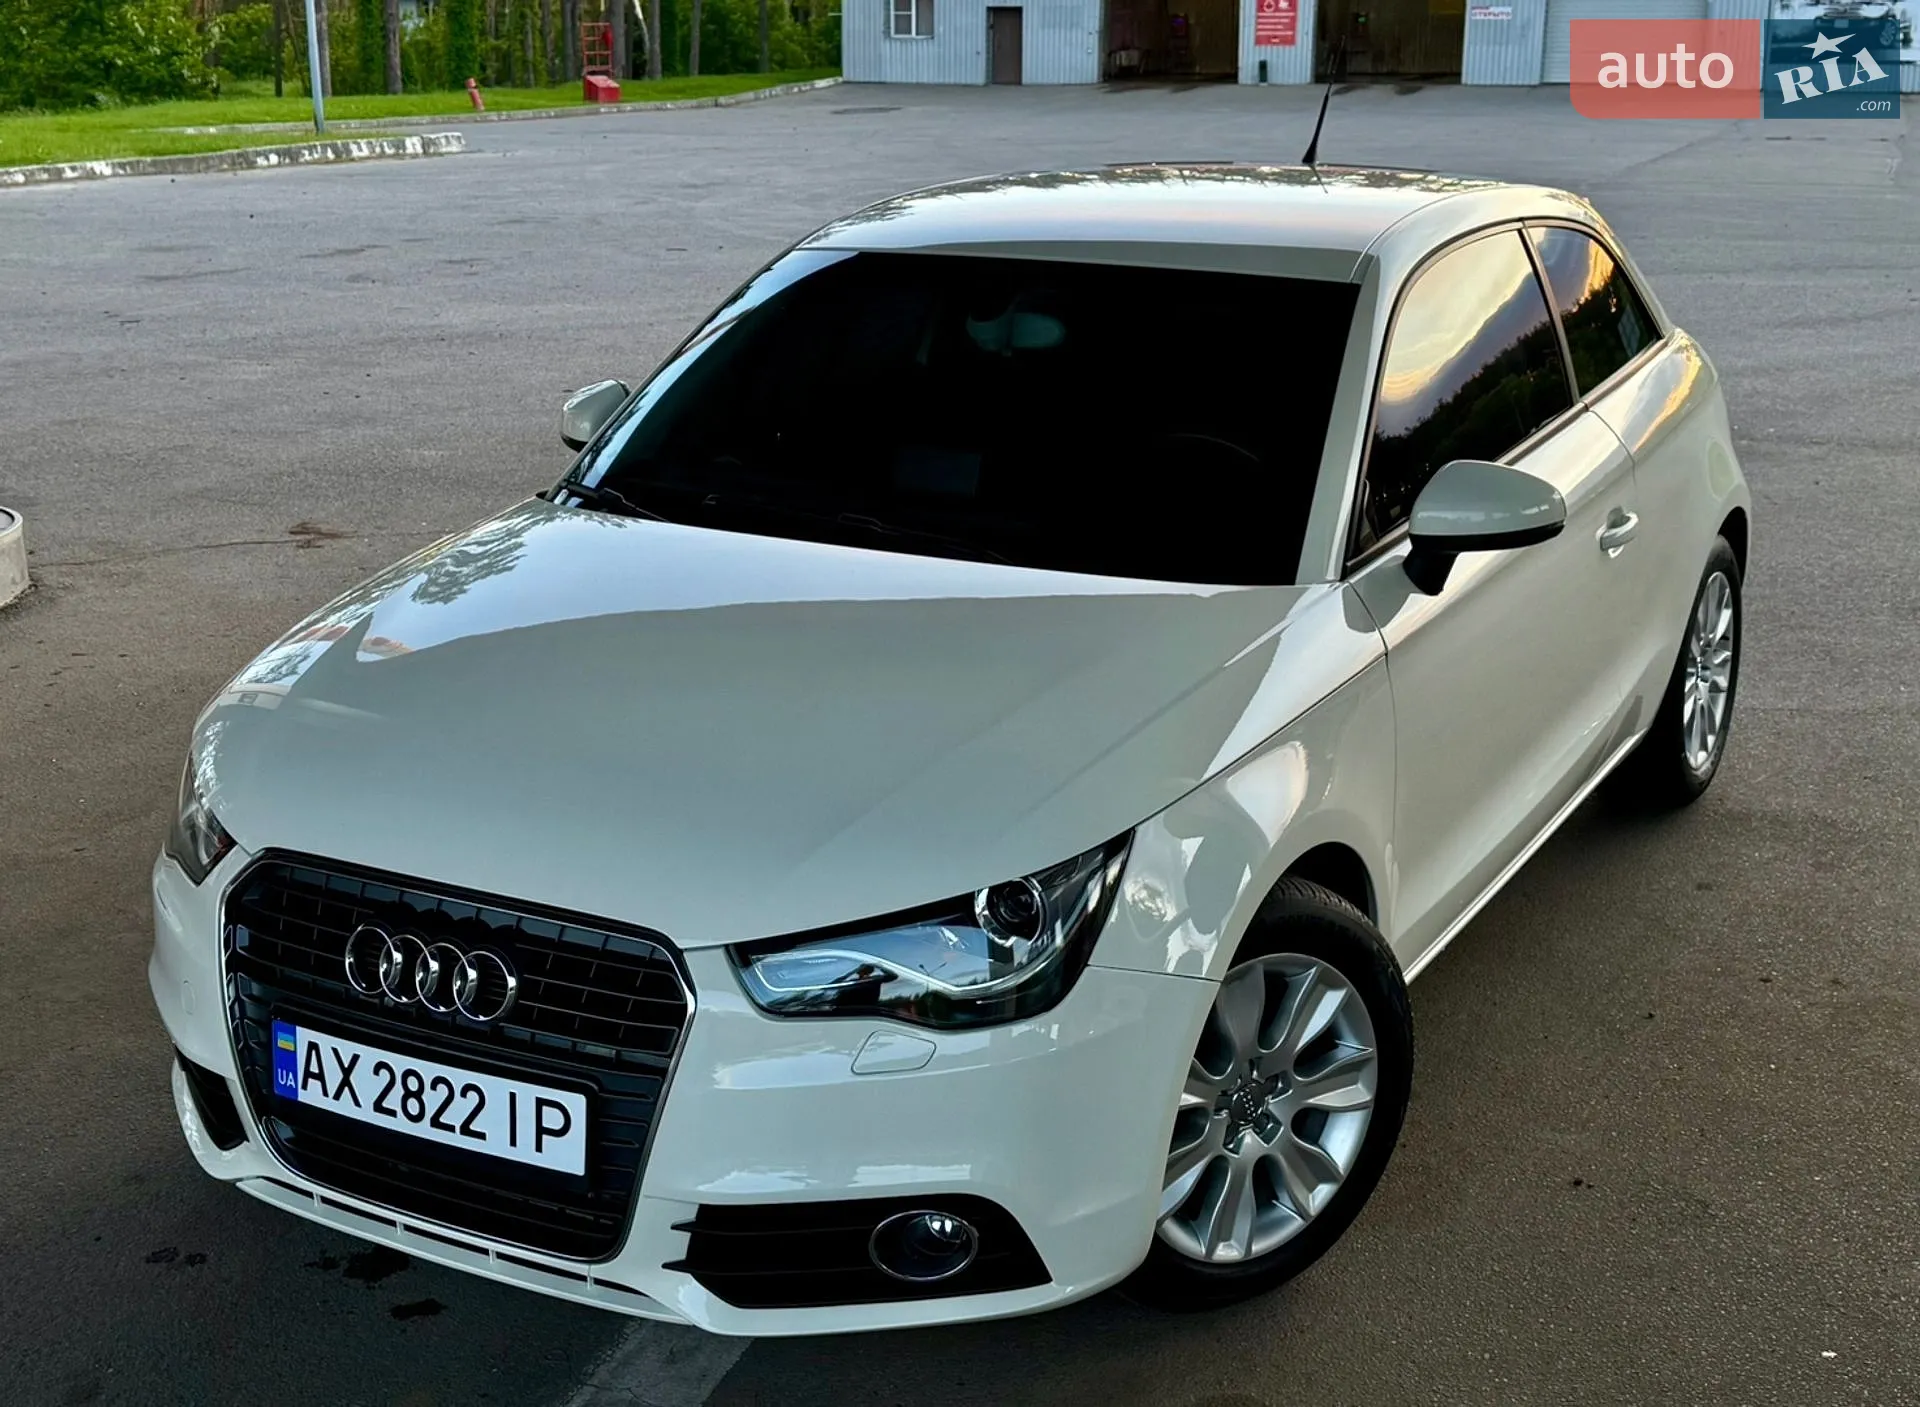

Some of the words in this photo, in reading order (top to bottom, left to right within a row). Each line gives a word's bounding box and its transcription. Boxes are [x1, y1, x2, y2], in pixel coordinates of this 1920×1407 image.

[277, 1068, 296, 1089] UA
[301, 1040, 362, 1109] AX
[372, 1060, 487, 1142] 2822
[509, 1091, 572, 1154] IP
